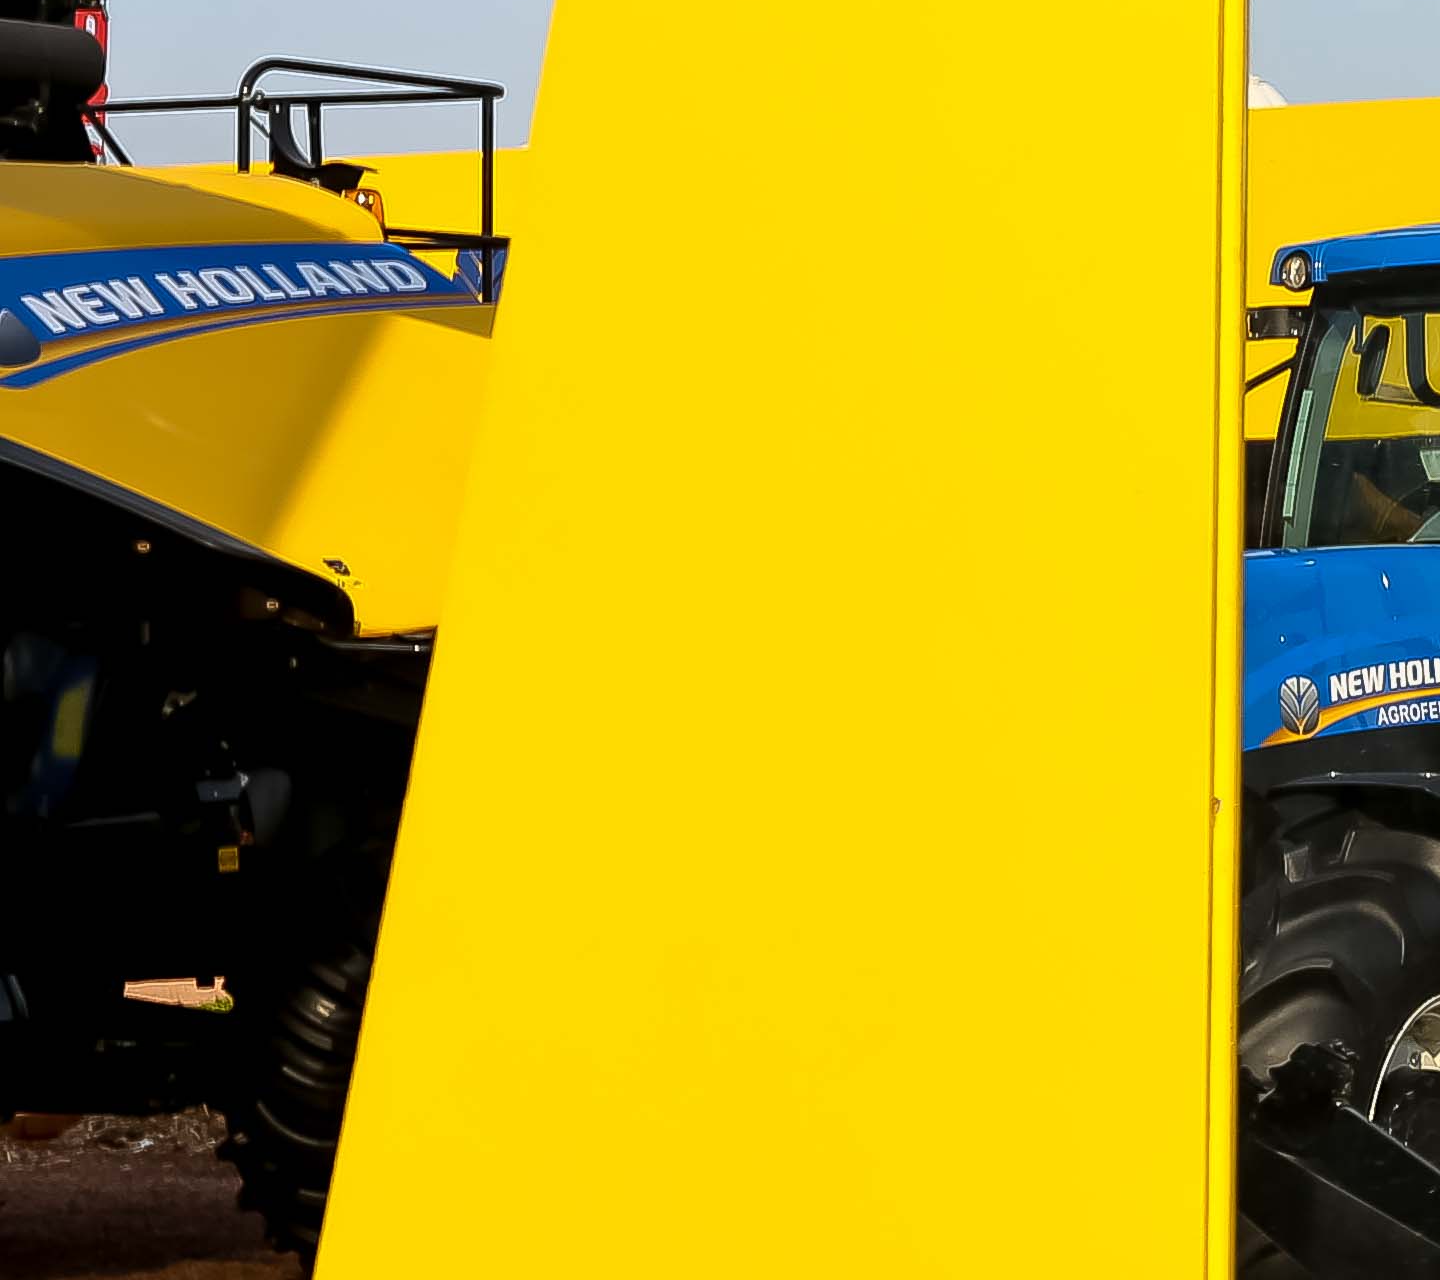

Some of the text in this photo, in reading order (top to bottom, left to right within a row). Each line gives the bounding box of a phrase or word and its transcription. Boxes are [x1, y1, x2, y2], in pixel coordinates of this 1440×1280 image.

[20, 259, 428, 334] NEW HOLLAND
[1329, 664, 1384, 703] NEW
